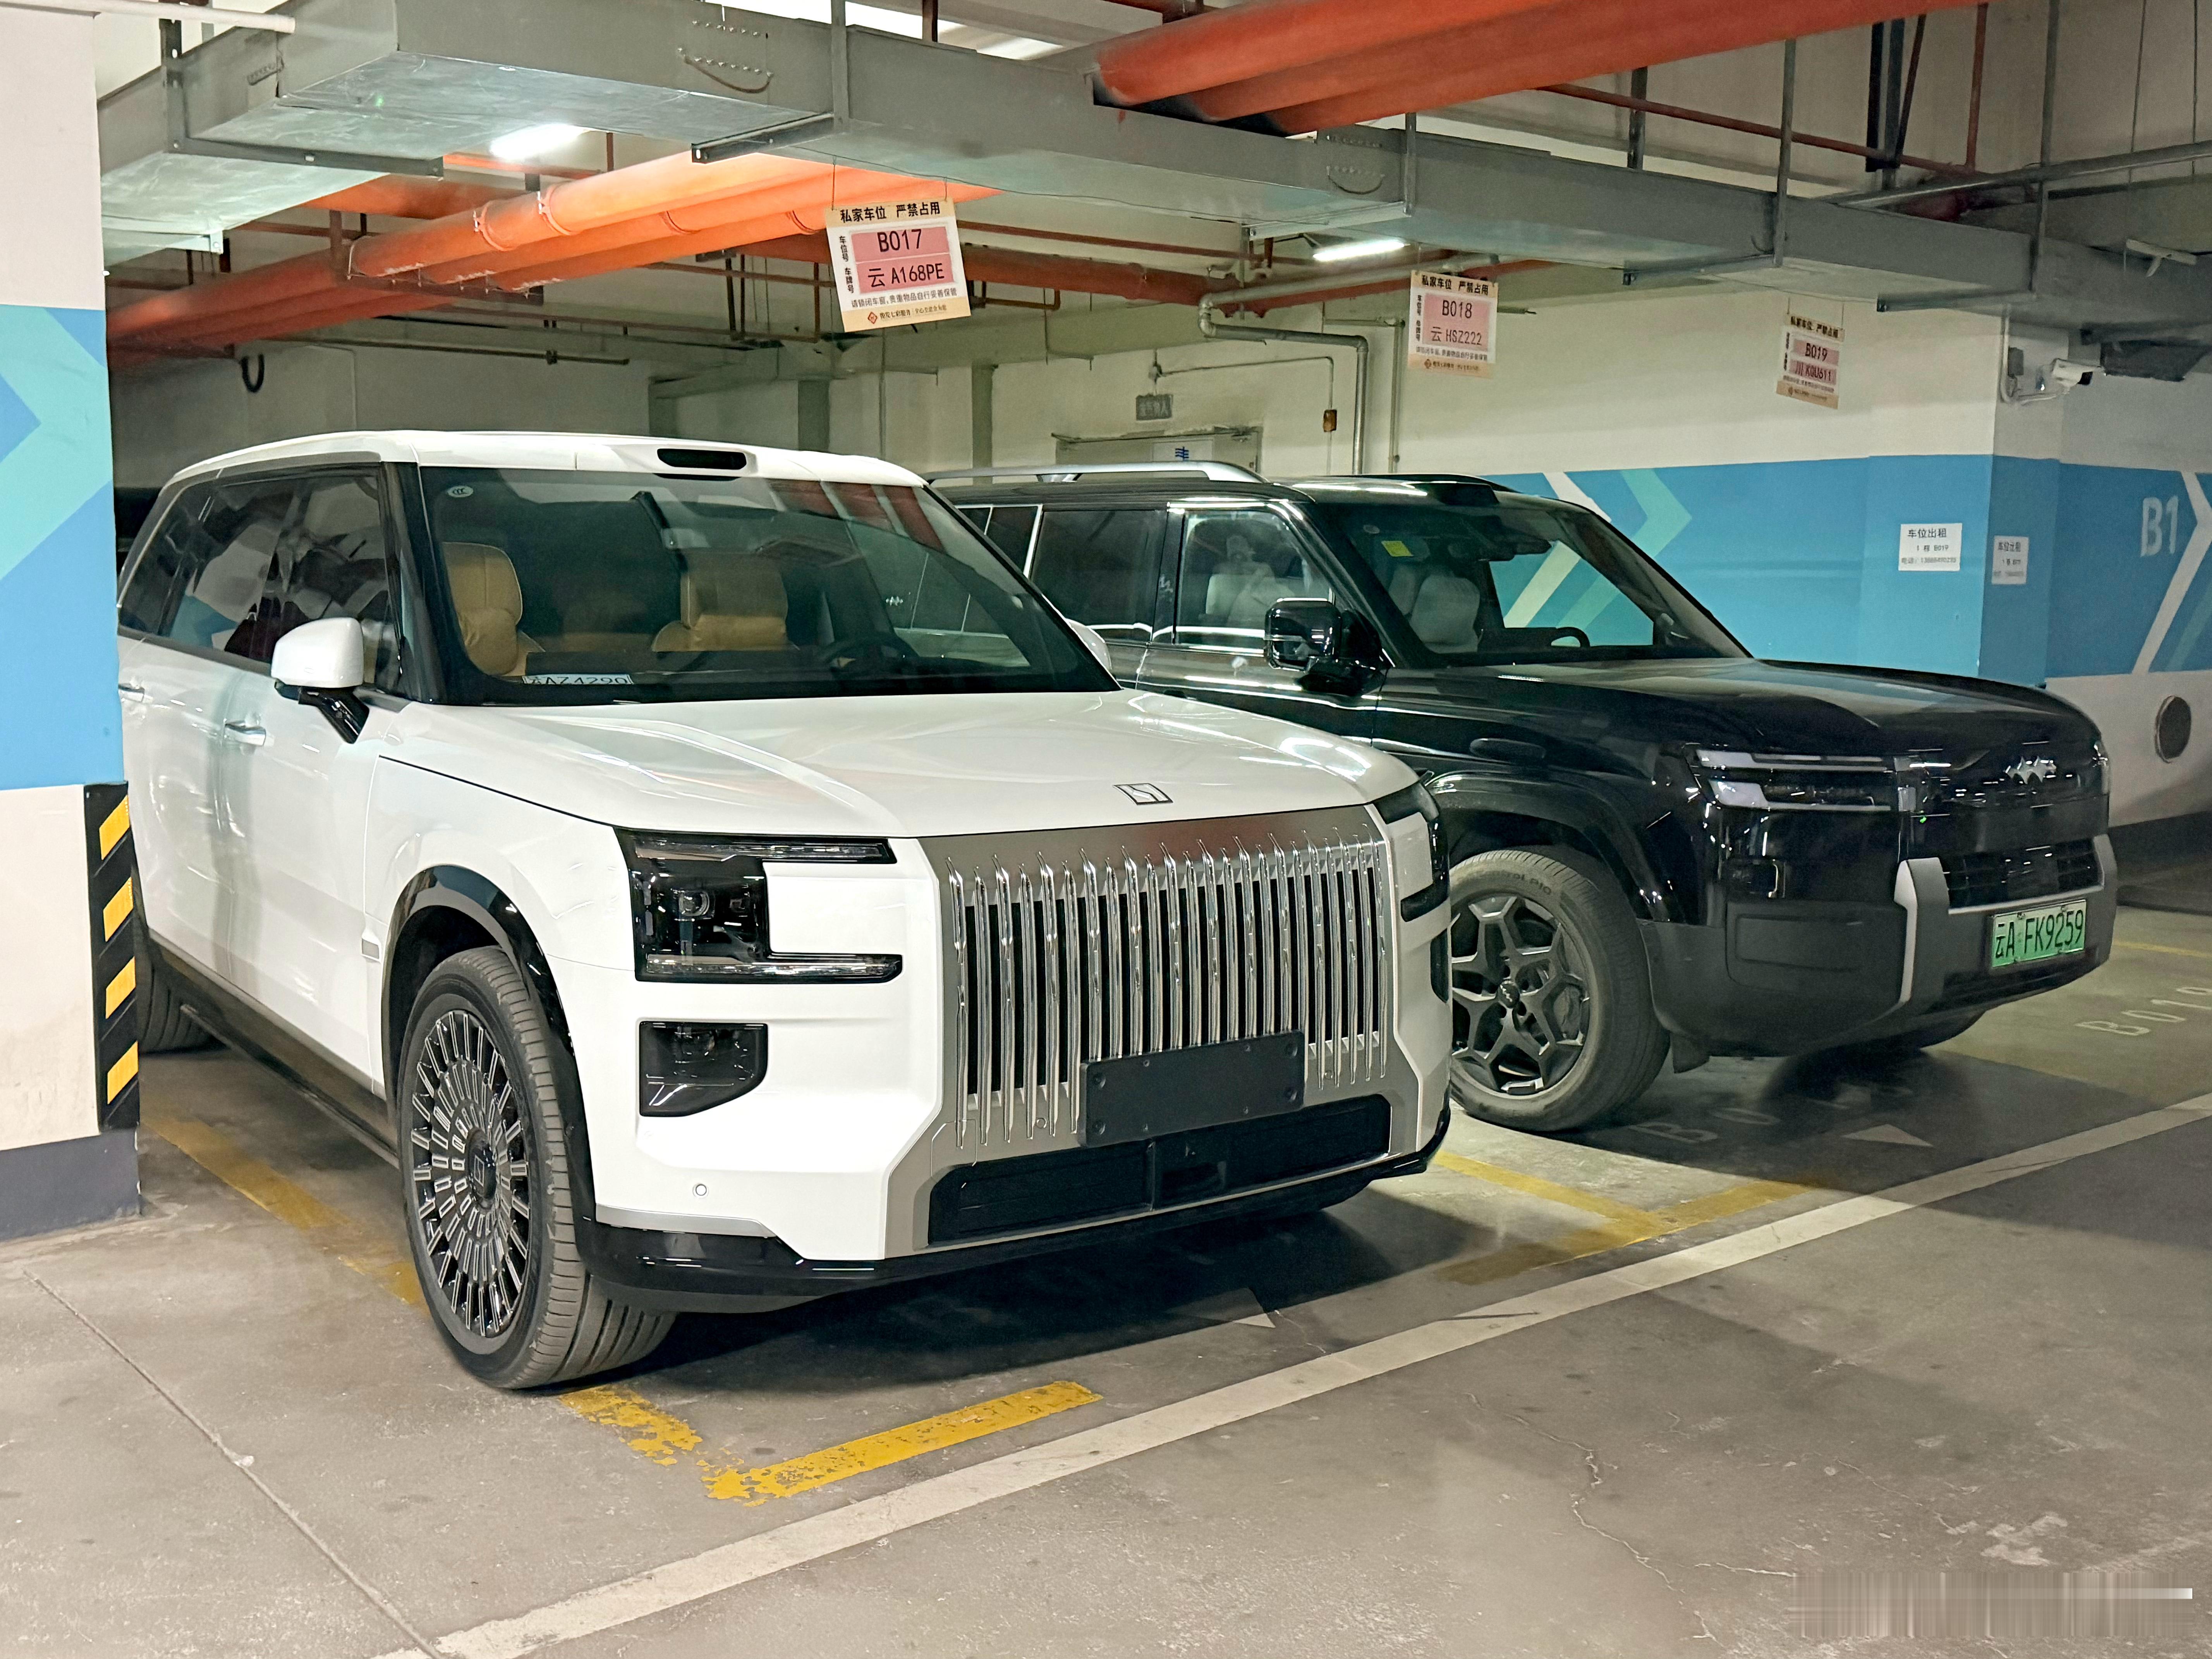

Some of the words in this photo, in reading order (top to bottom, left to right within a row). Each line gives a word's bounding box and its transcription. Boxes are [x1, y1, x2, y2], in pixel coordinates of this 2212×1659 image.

[840, 206, 887, 223] 私家车位
[896, 202, 940, 218] 严禁占用
[877, 228, 922, 252] B017
[868, 268, 885, 288] 云
[891, 263, 945, 285] A168PE
[1442, 299, 1472, 319] B018
[1431, 326, 1442, 342] 云
[1446, 329, 1482, 346] HSZ222
[1805, 342, 1828, 362] B019
[1908, 528, 1947, 539] 车位出租
[2140, 495, 2179, 557] B1
[2025, 909, 2083, 954] FK9259
